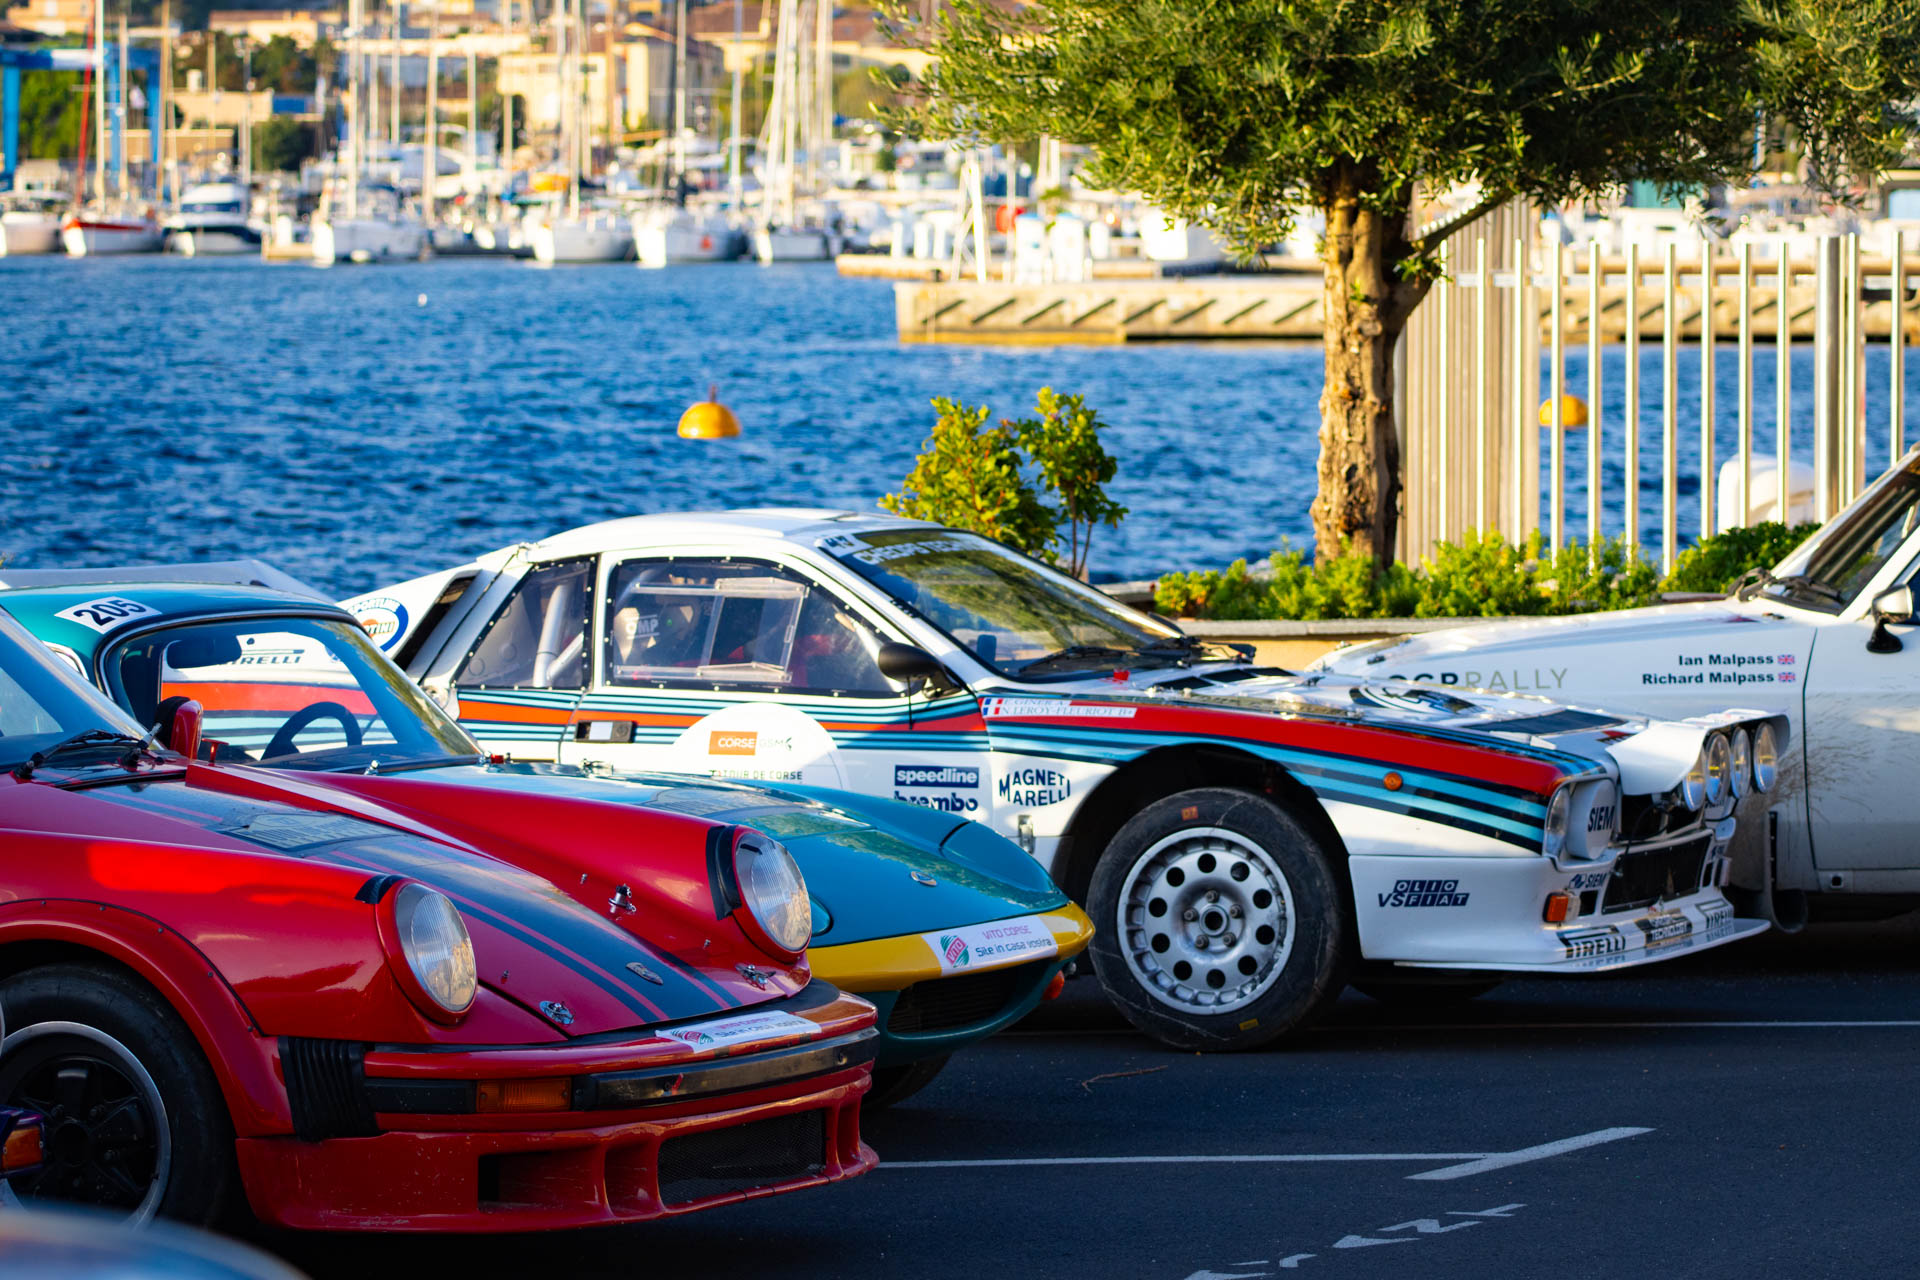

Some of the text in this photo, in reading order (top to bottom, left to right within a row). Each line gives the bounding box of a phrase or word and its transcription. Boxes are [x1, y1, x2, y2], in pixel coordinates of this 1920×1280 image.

[73, 600, 147, 626] 205
[1678, 654, 1774, 667] Ian Malpass
[1642, 672, 1775, 685] Richard Malpass
[718, 738, 756, 749] CORSE
[769, 771, 803, 781] CORSE
[896, 768, 978, 784] speedline
[999, 769, 1071, 796] MAGNETI
[1587, 806, 1615, 832] SIEM
[1394, 880, 1459, 892] OLIO
[1557, 924, 1627, 958] PIRELLI
[996, 943, 1005, 953] in
[1006, 943, 1027, 952] casa
